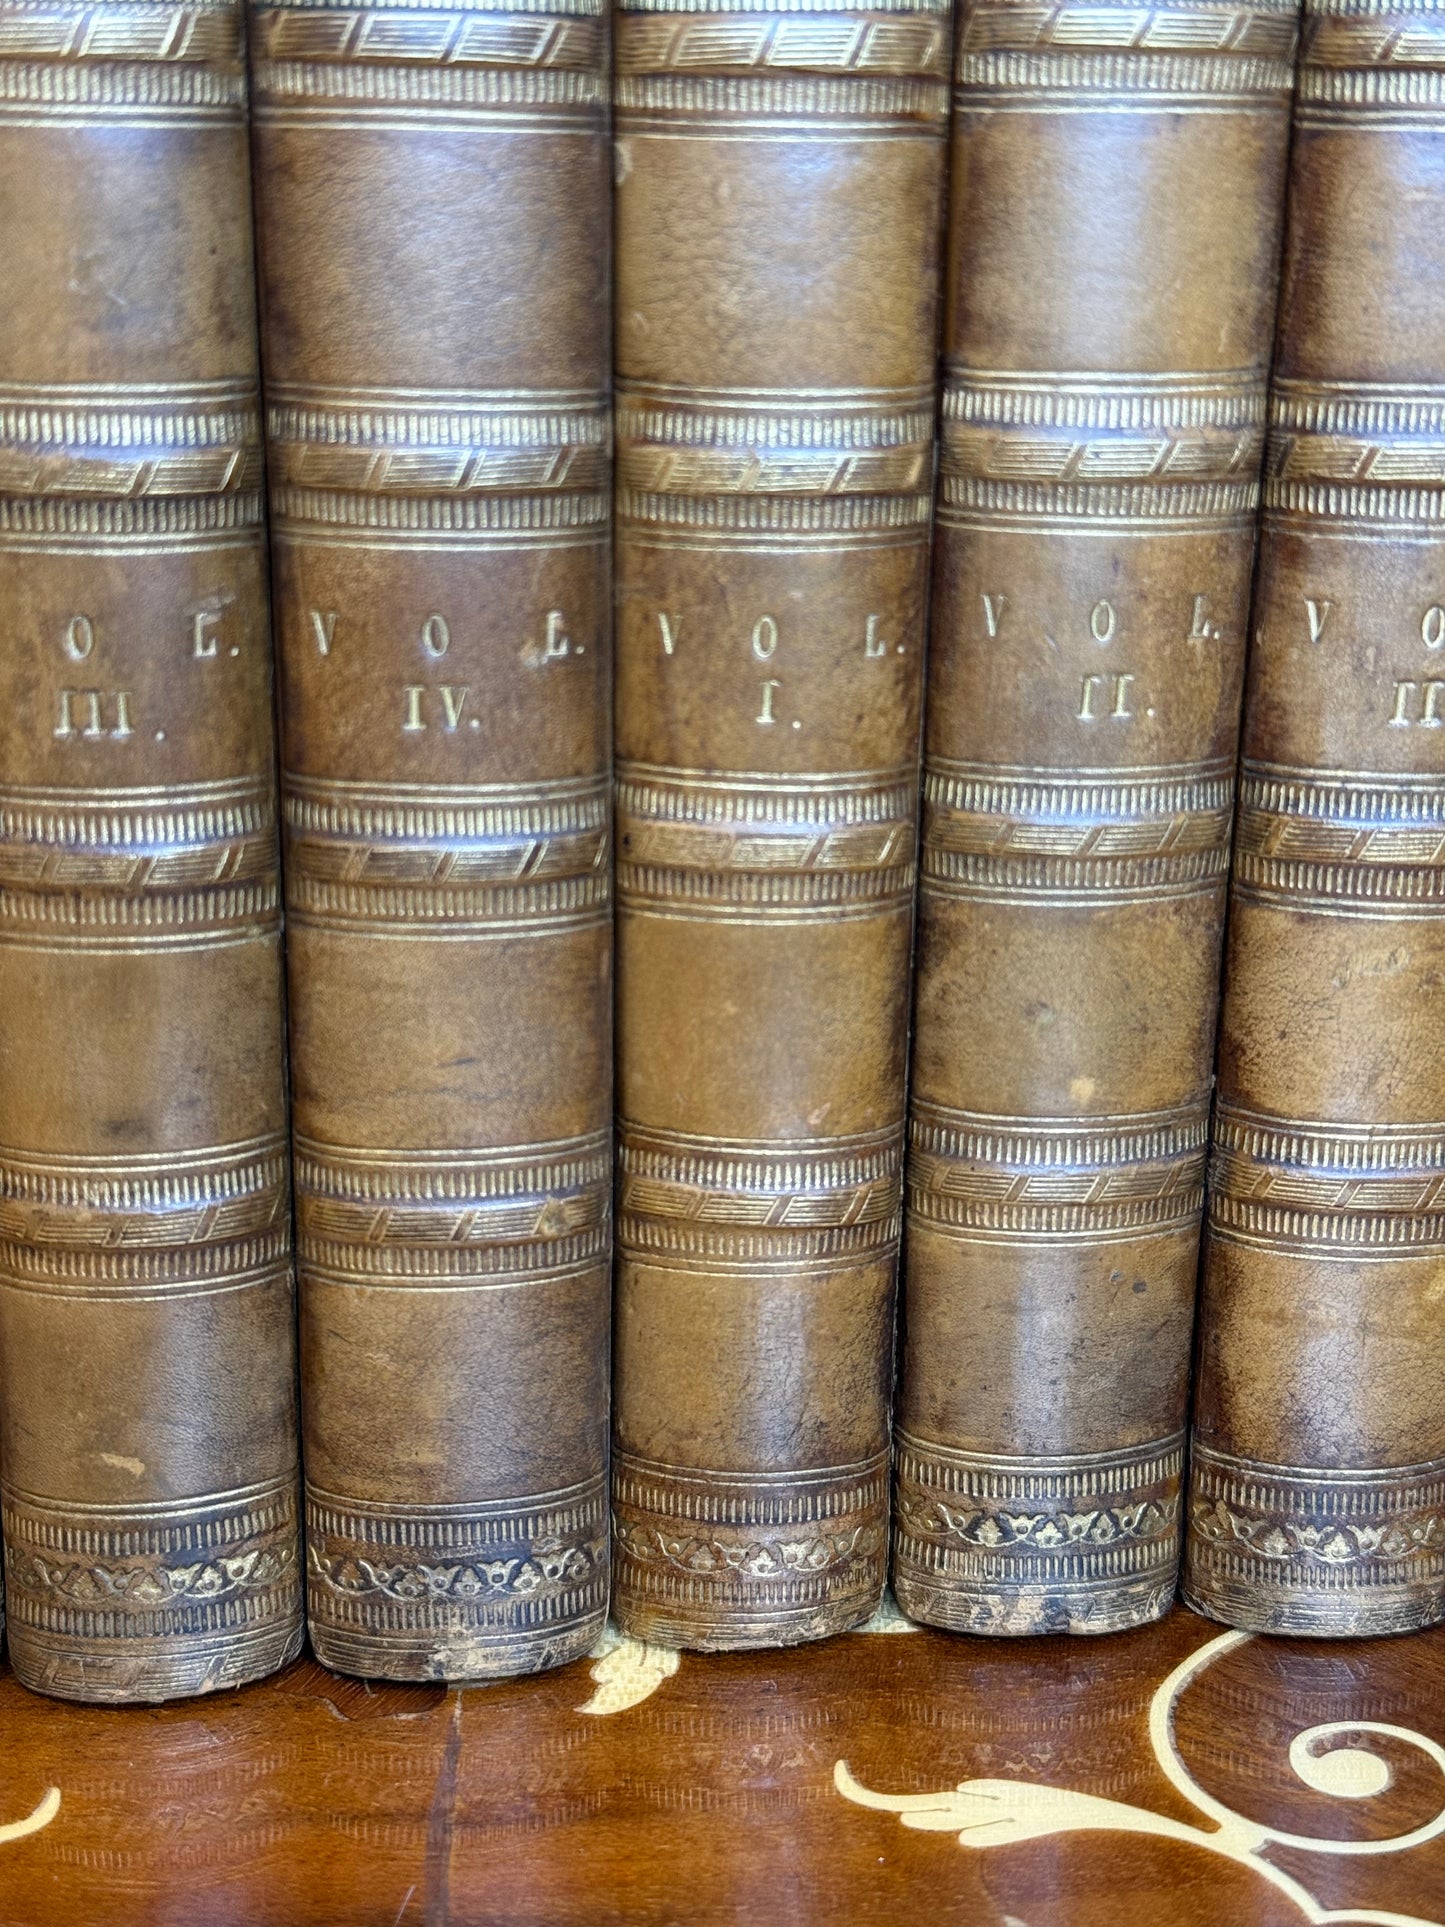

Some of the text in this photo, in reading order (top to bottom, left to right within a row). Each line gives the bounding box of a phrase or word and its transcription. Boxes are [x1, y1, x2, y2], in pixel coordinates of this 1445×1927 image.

[64, 611, 240, 660] OL.
[1303, 599, 1445, 649] VO
[53, 690, 166, 742] III.
[403, 685, 480, 731] IV.
[755, 679, 801, 729] I.
[1075, 673, 1155, 718] II.
[1388, 681, 1445, 728] II
